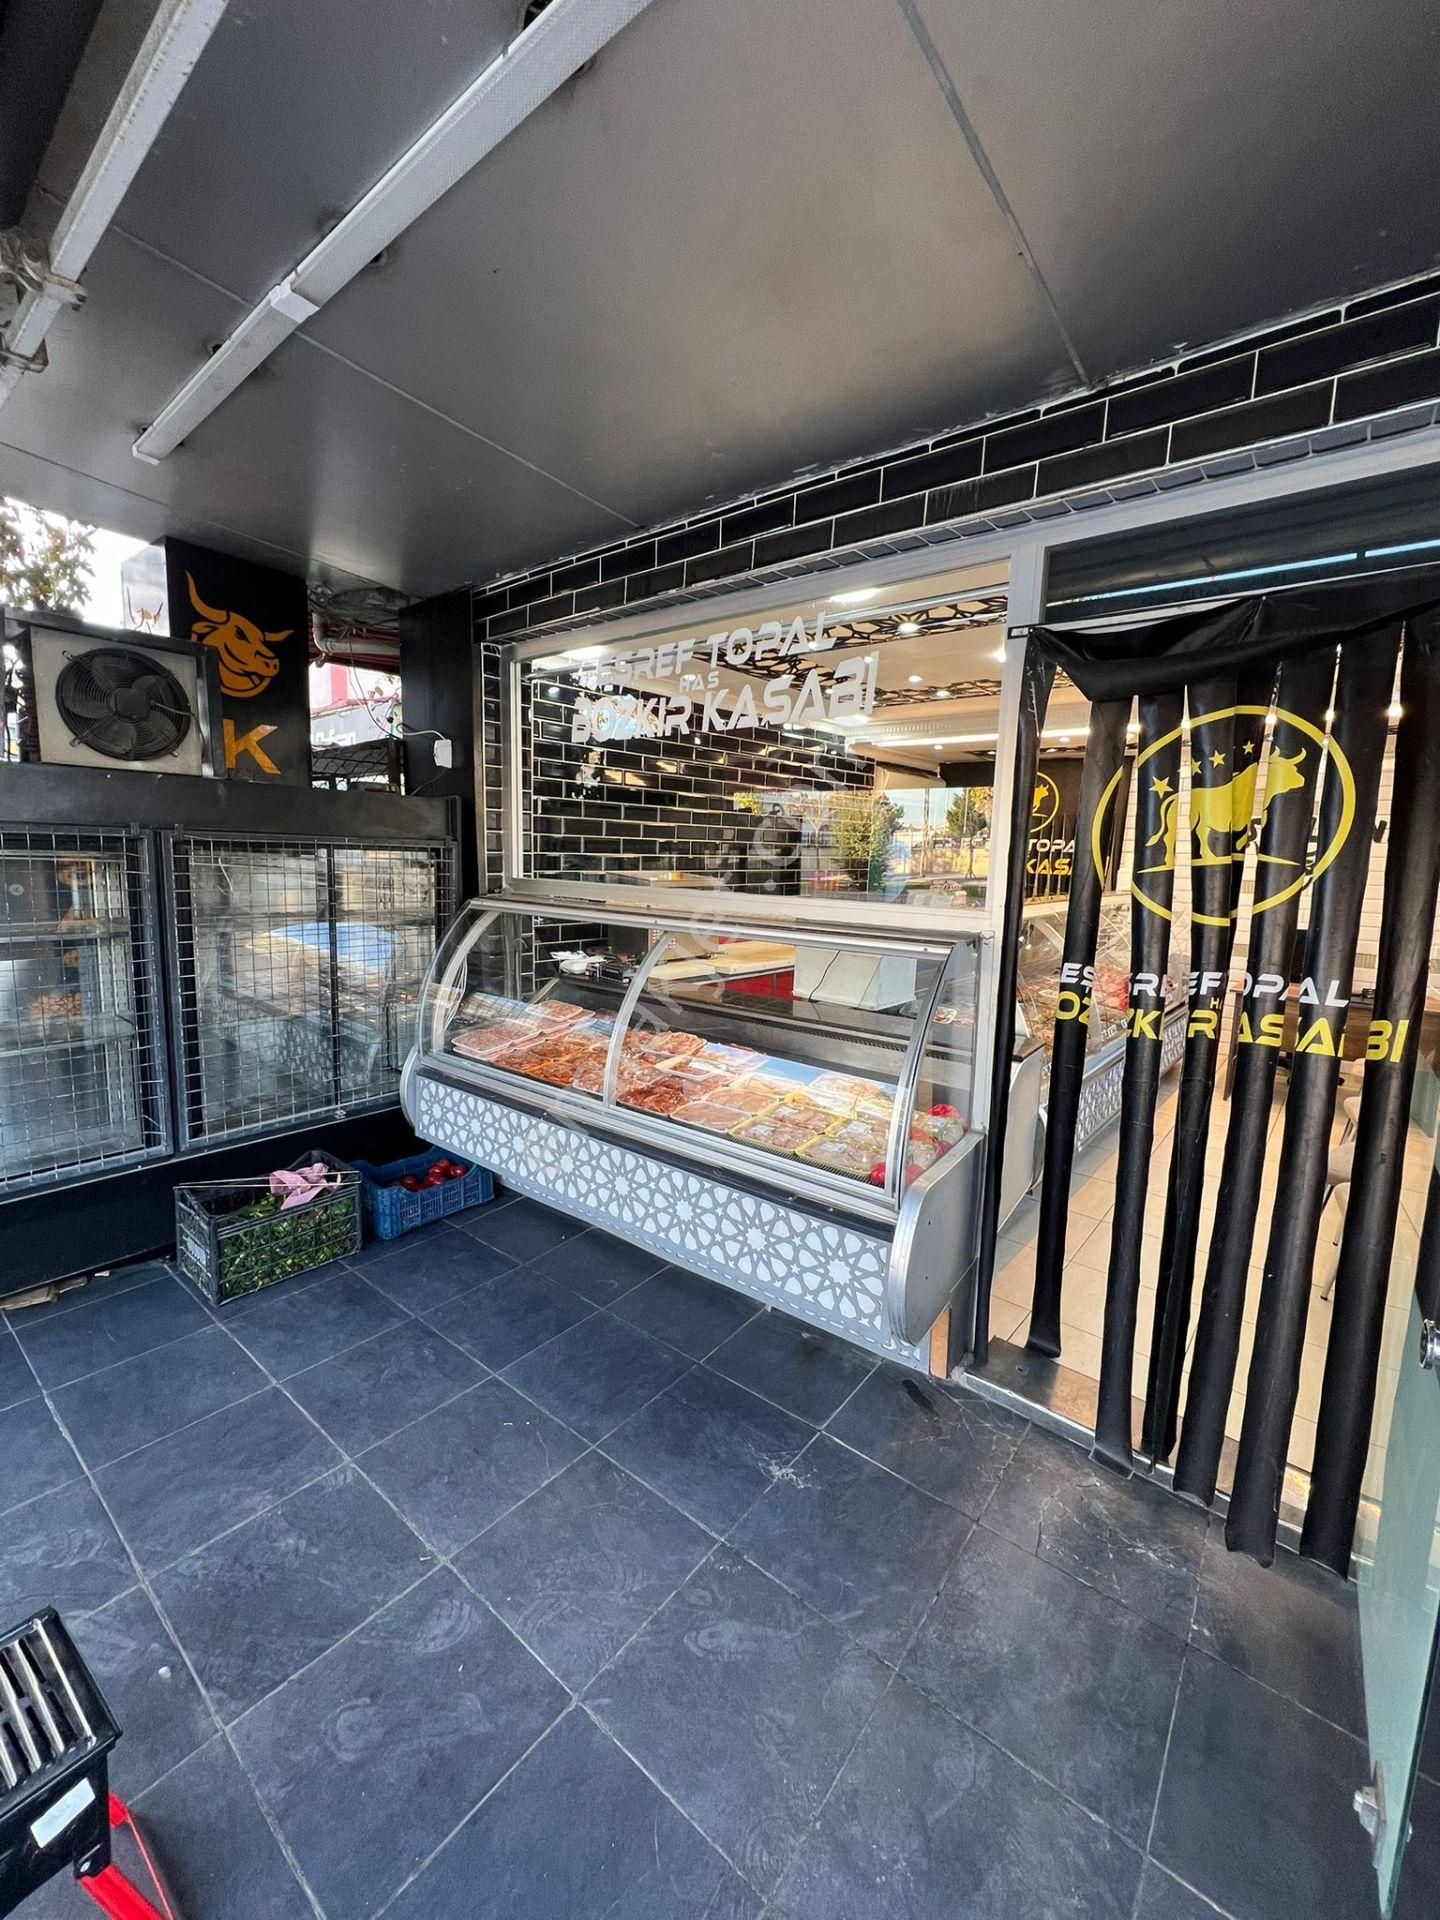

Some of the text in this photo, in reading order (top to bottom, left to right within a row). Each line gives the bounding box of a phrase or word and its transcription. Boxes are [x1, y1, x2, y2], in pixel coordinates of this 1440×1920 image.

[706, 611, 837, 669] TOPAL
[572, 651, 879, 743] BOZKIR KASABI
[680, 671, 719, 692] HAS
[1028, 838, 1076, 853] TOPA
[1238, 1011, 1410, 1063] ASABI
